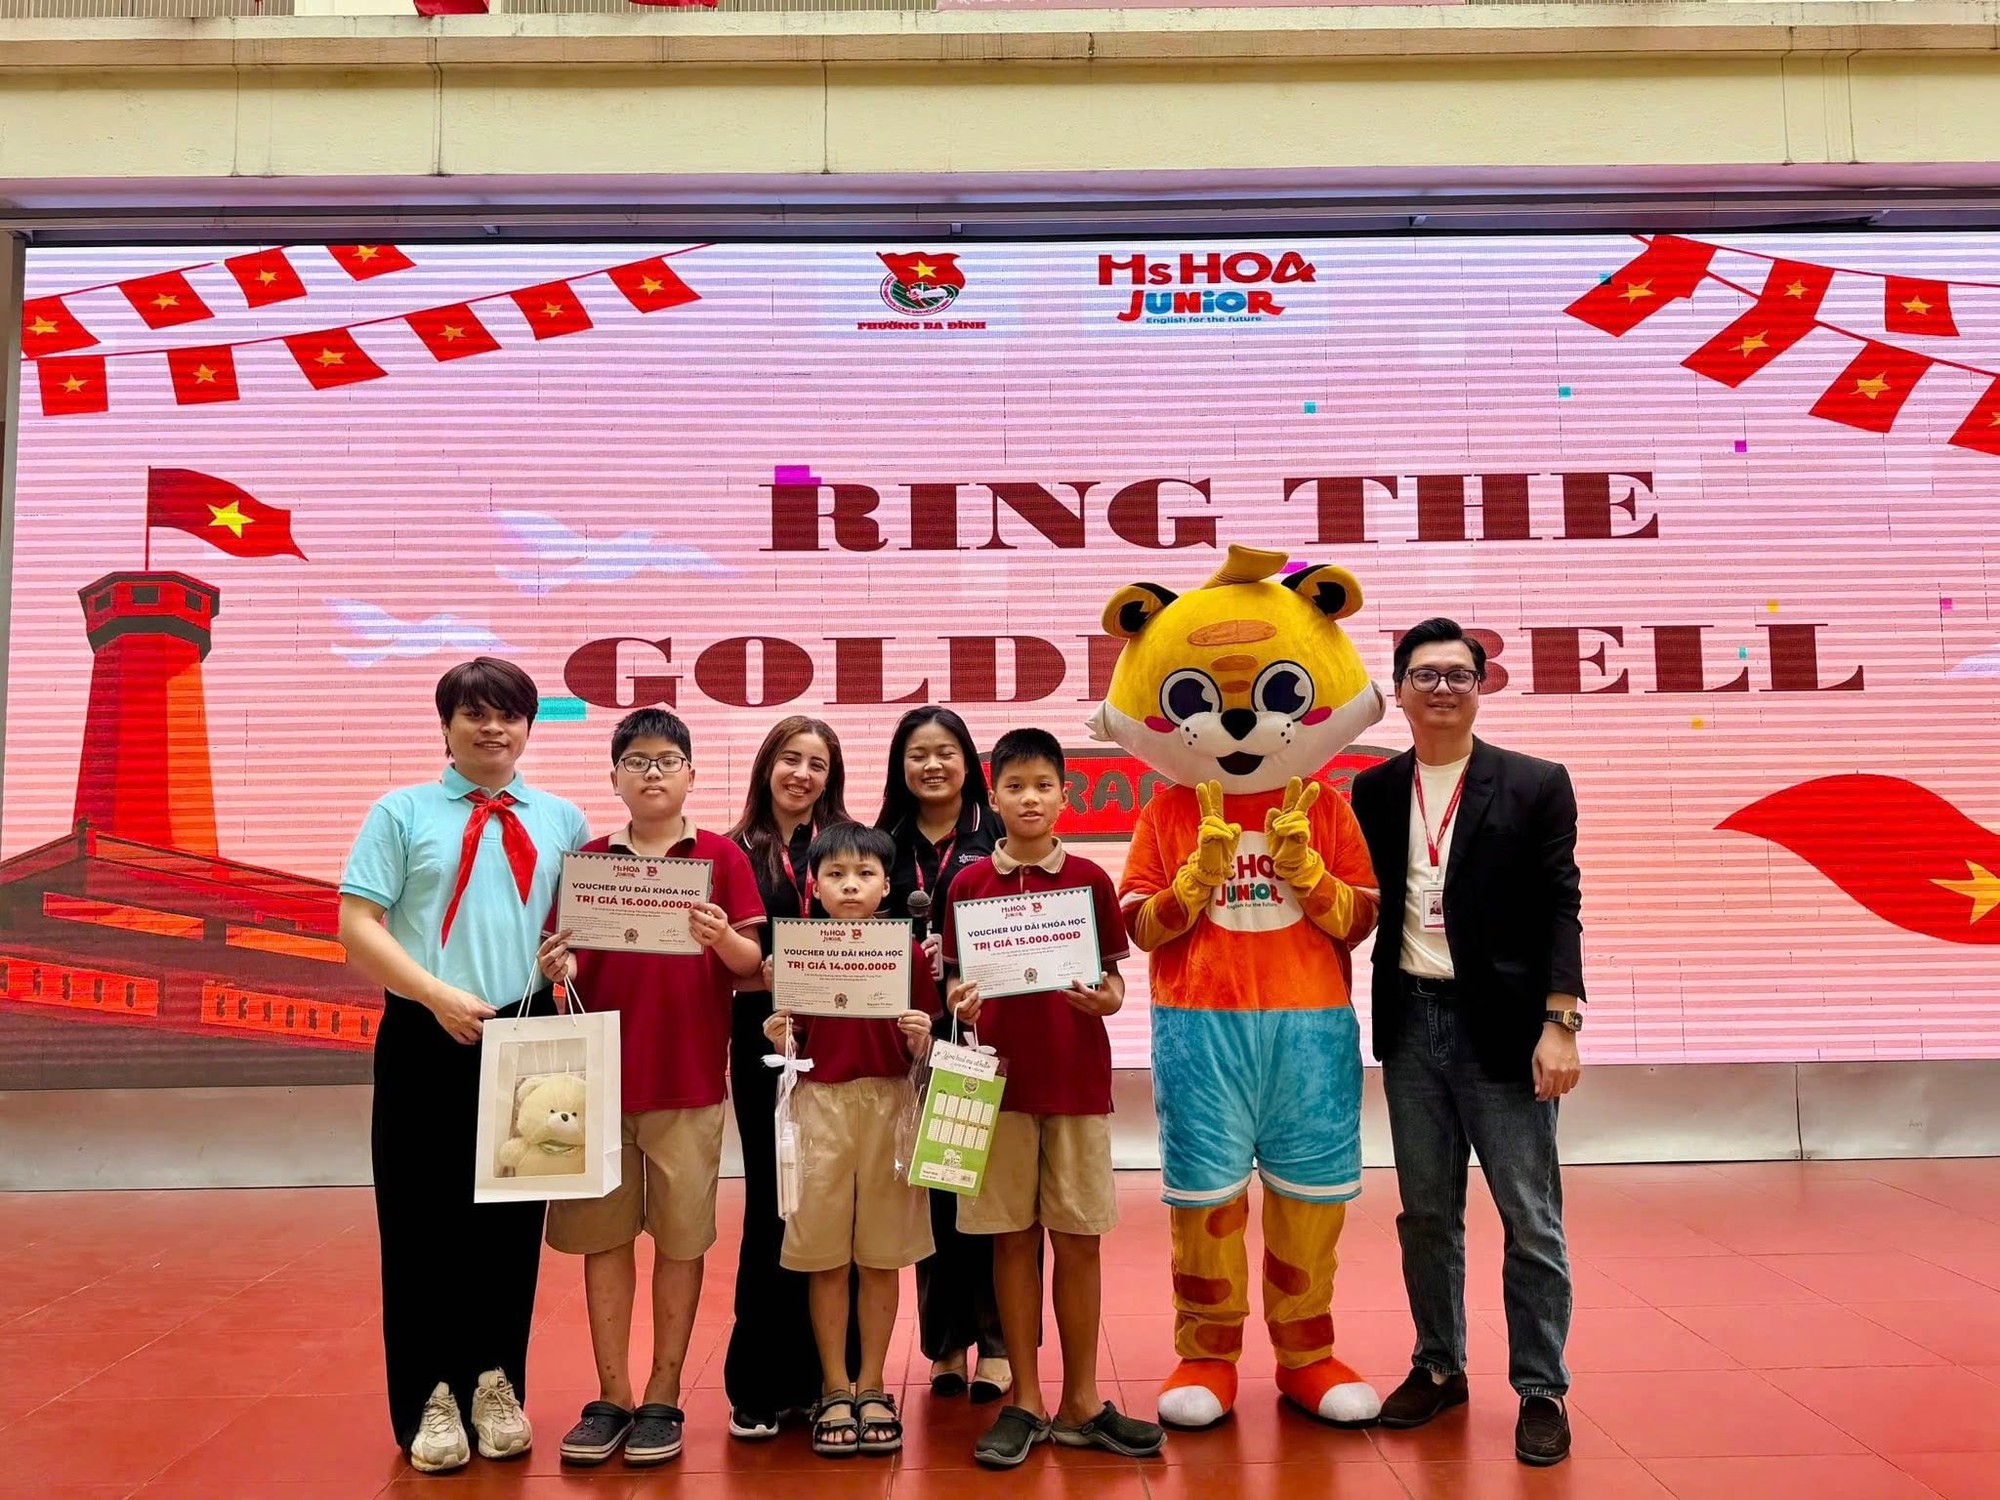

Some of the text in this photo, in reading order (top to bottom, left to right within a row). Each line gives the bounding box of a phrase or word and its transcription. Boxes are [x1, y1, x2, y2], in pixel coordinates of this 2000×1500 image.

[923, 321, 943, 330] BA
[947, 320, 986, 330] ĐÌNH
[1146, 316, 1186, 324] English
[1188, 316, 1205, 324] for
[758, 471, 1659, 553] RING THE
[563, 634, 1128, 710] GOLD
[572, 882, 616, 892] VOUCHER
[652, 886, 679, 895] KHÓA
[680, 888, 701, 897] HỌC
[575, 894, 693, 909] TRỊ GIÁ 16.000.000Đ
[968, 926, 1008, 938] VOUCHER
[1041, 919, 1065, 929] KHÓA
[1068, 917, 1086, 927] HỌC
[973, 940, 991, 952] TRỊ
[993, 937, 1013, 949] GIÁ
[1015, 931, 1081, 946] 15.000.000Đ
[784, 948, 825, 957] VOUCHER
[858, 948, 883, 957] KHÓA
[884, 949, 903, 958] HỌC
[787, 959, 897, 972] TRỊ GIÁ 14.000.000Đ
